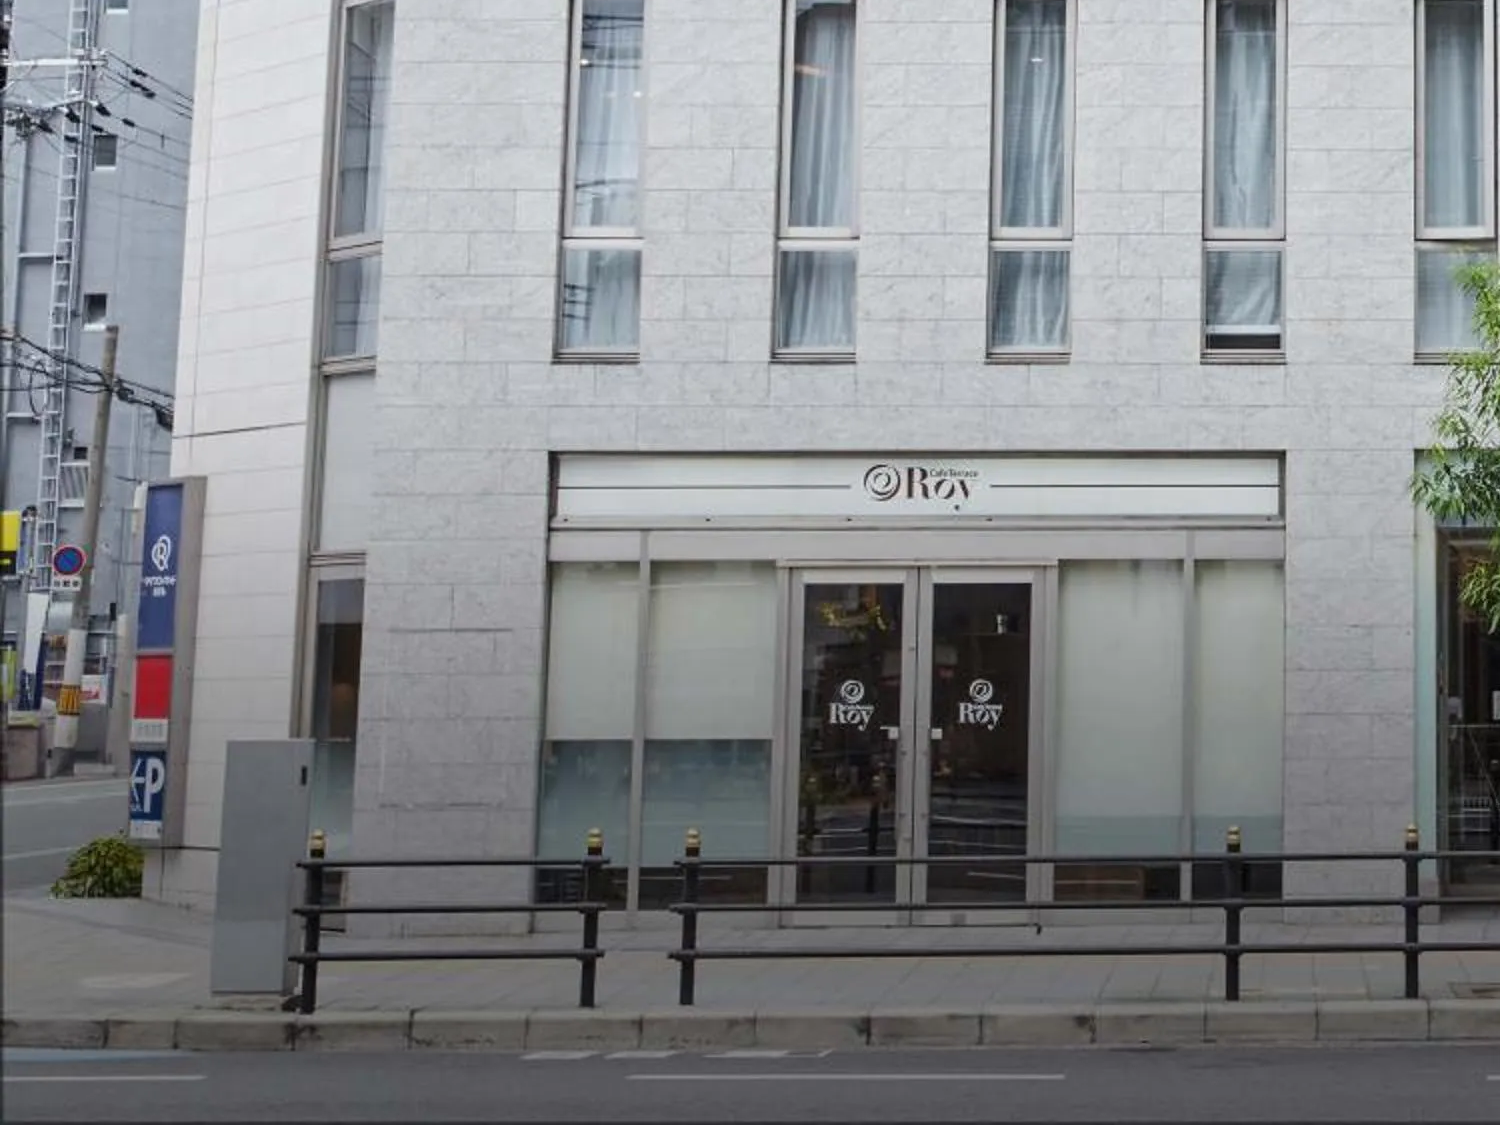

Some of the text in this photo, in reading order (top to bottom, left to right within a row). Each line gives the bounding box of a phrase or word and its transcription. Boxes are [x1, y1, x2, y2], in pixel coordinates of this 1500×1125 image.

[829, 702, 875, 732] Roy
[959, 702, 1003, 731] Roy
[143, 757, 165, 813] P
